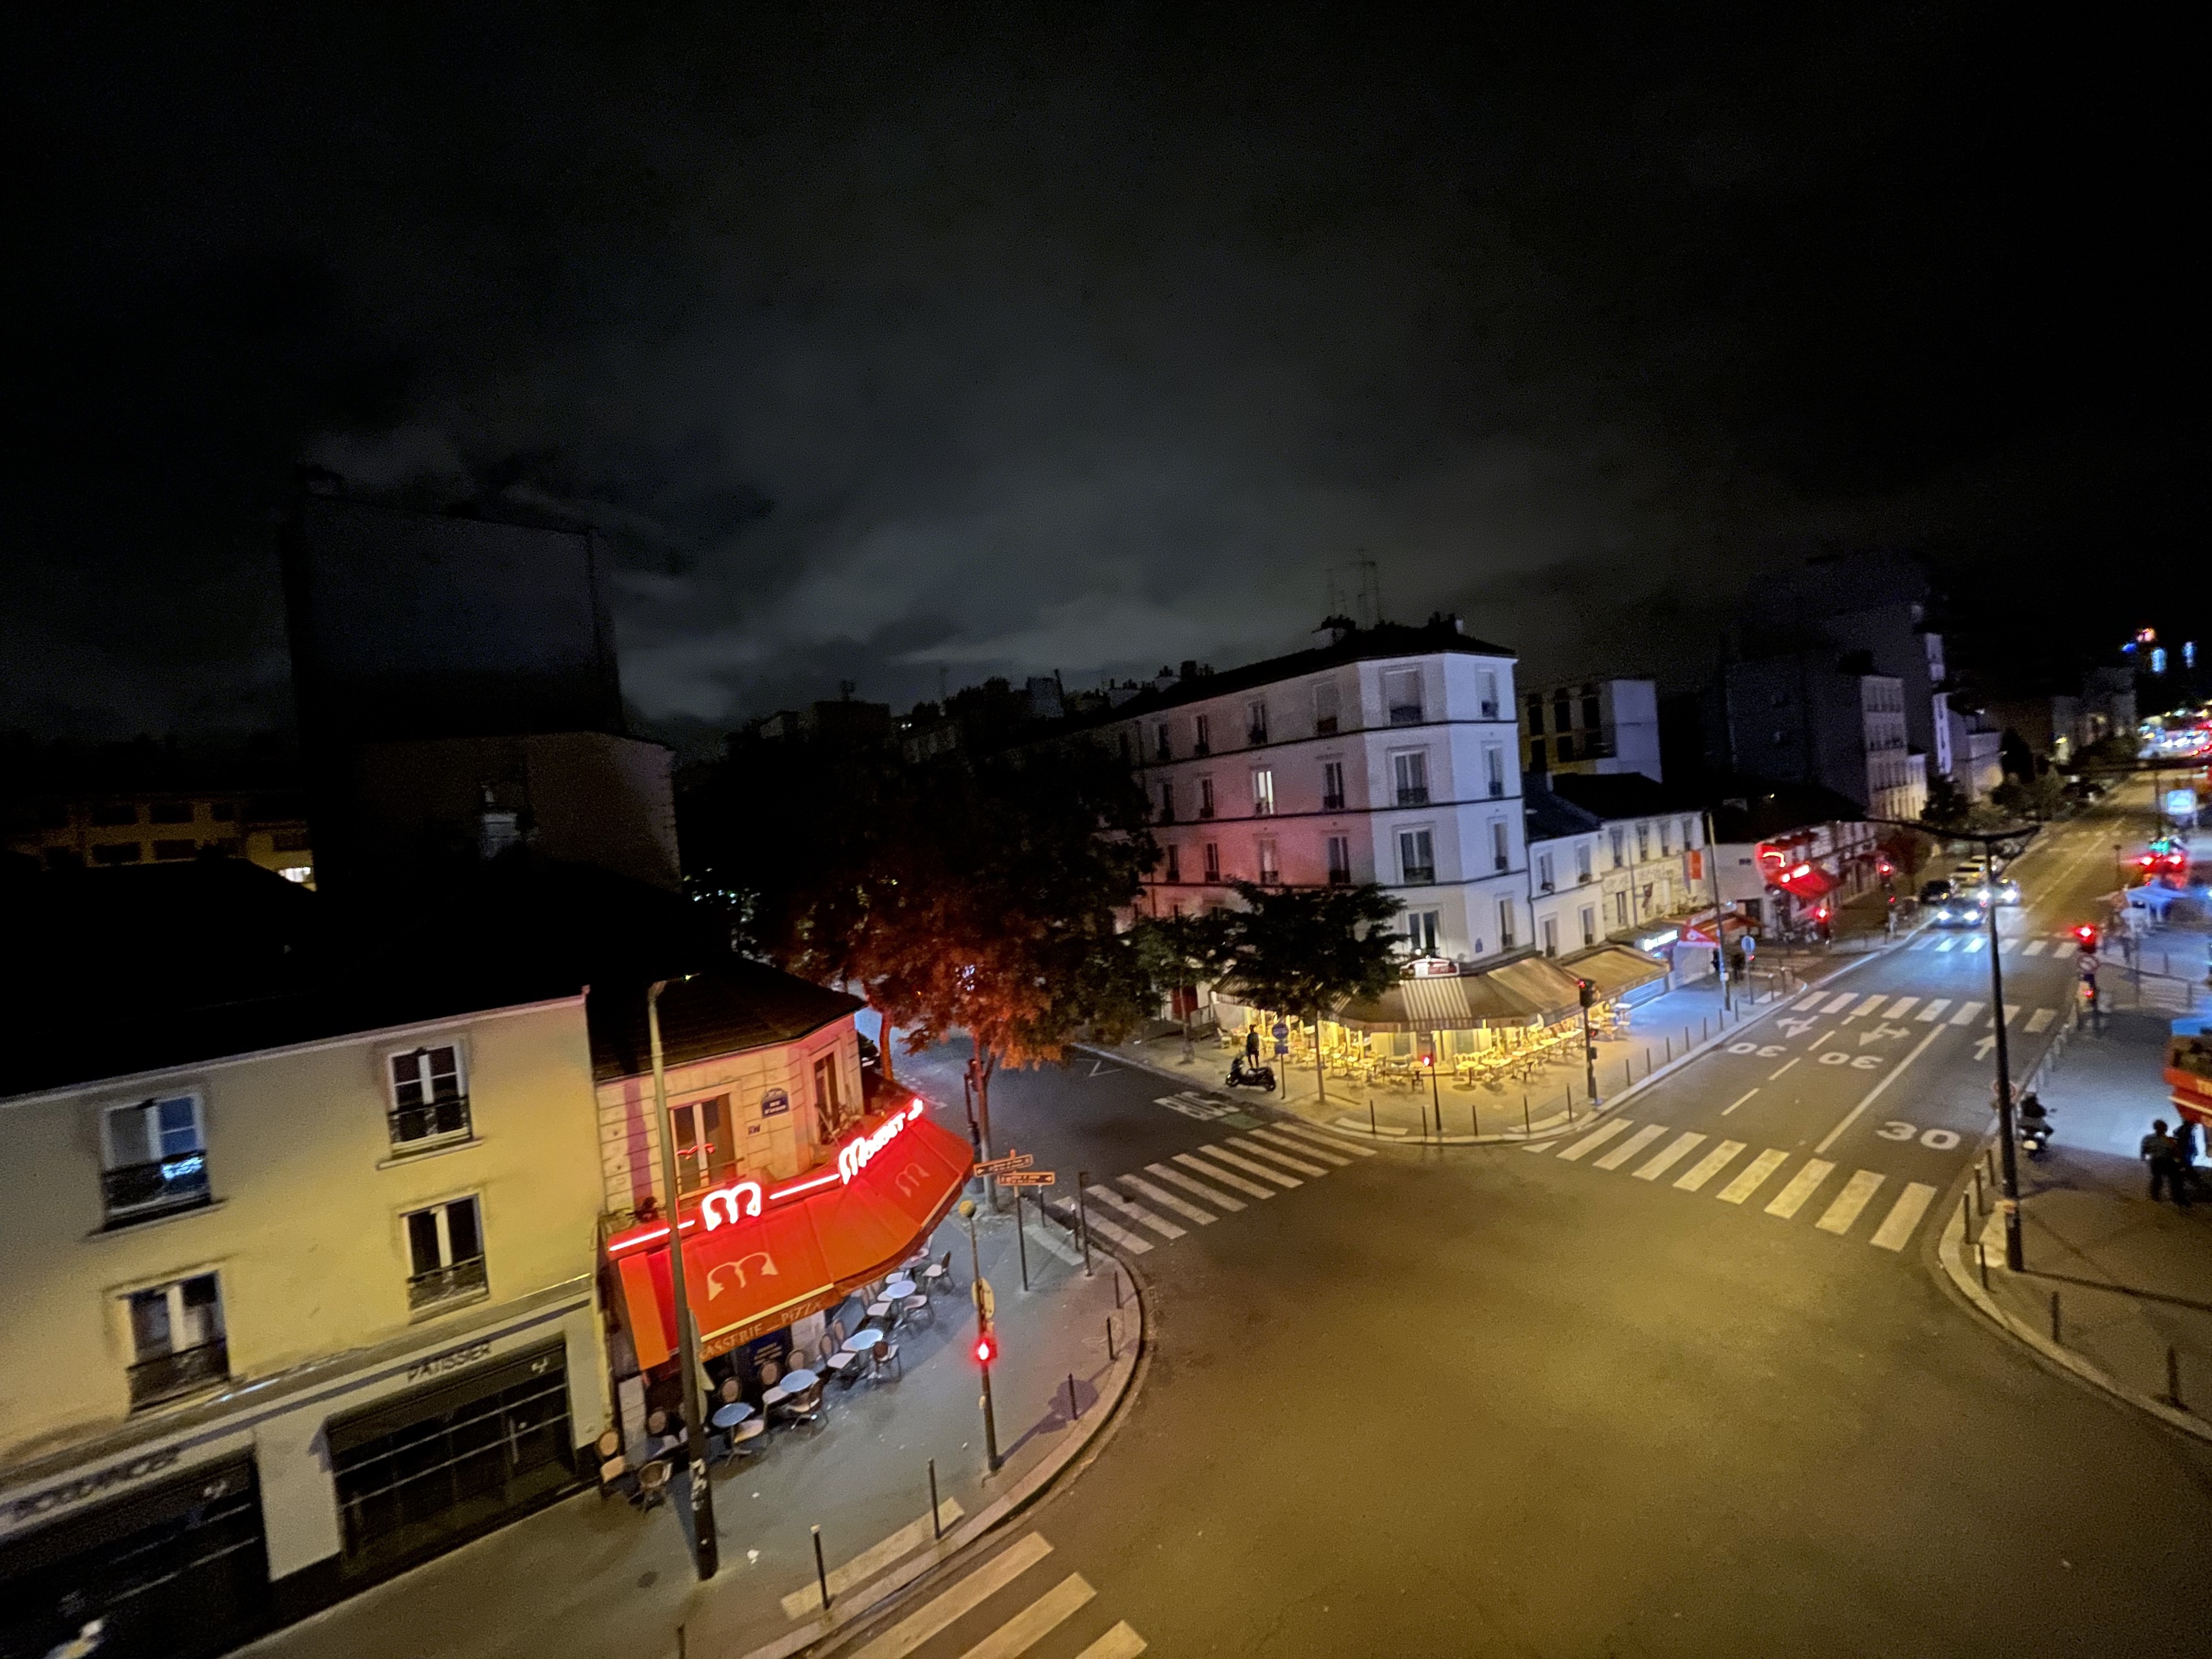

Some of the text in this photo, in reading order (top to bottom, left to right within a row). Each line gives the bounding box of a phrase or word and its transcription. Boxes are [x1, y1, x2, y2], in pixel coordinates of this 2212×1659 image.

[1727, 1042, 1787, 1057] 30
[1819, 1052, 1884, 1069] 30
[1876, 1121, 1961, 1150] 30
